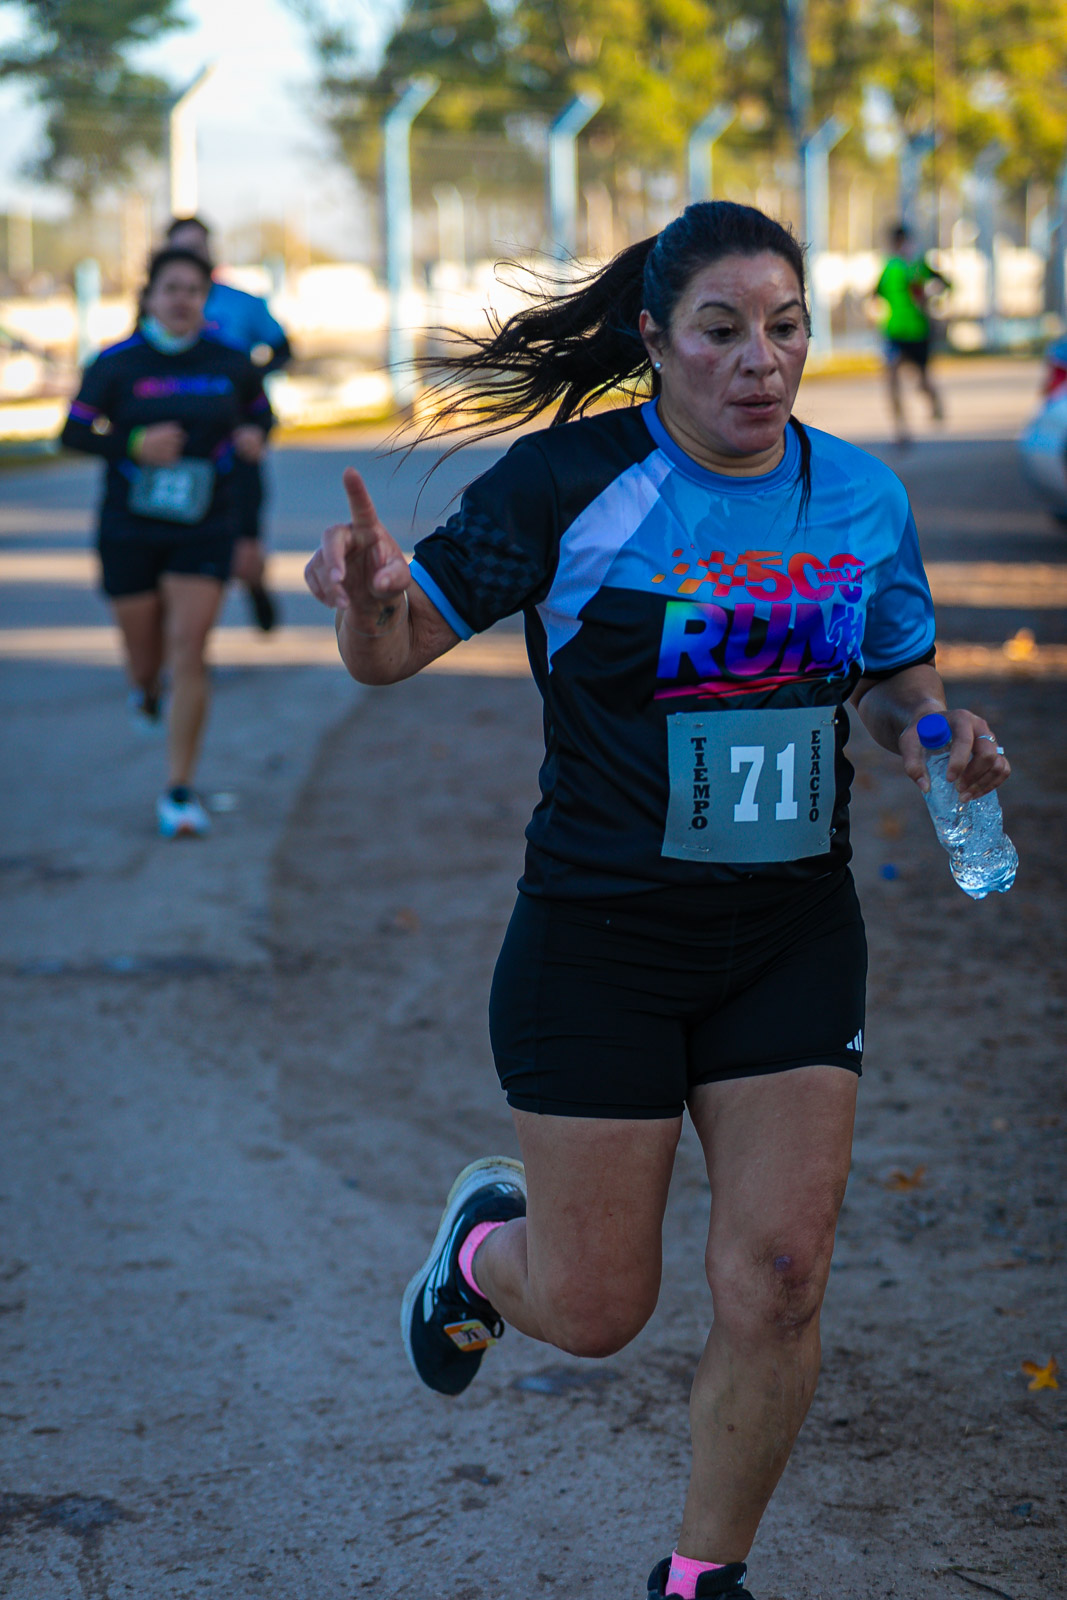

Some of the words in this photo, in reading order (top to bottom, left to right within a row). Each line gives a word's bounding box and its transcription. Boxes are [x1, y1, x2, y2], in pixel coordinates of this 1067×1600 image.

[656, 601, 853, 679] RUN
[690, 737, 710, 830] TIEMPO
[730, 743, 798, 822] 71
[809, 730, 821, 822] EXACTO
